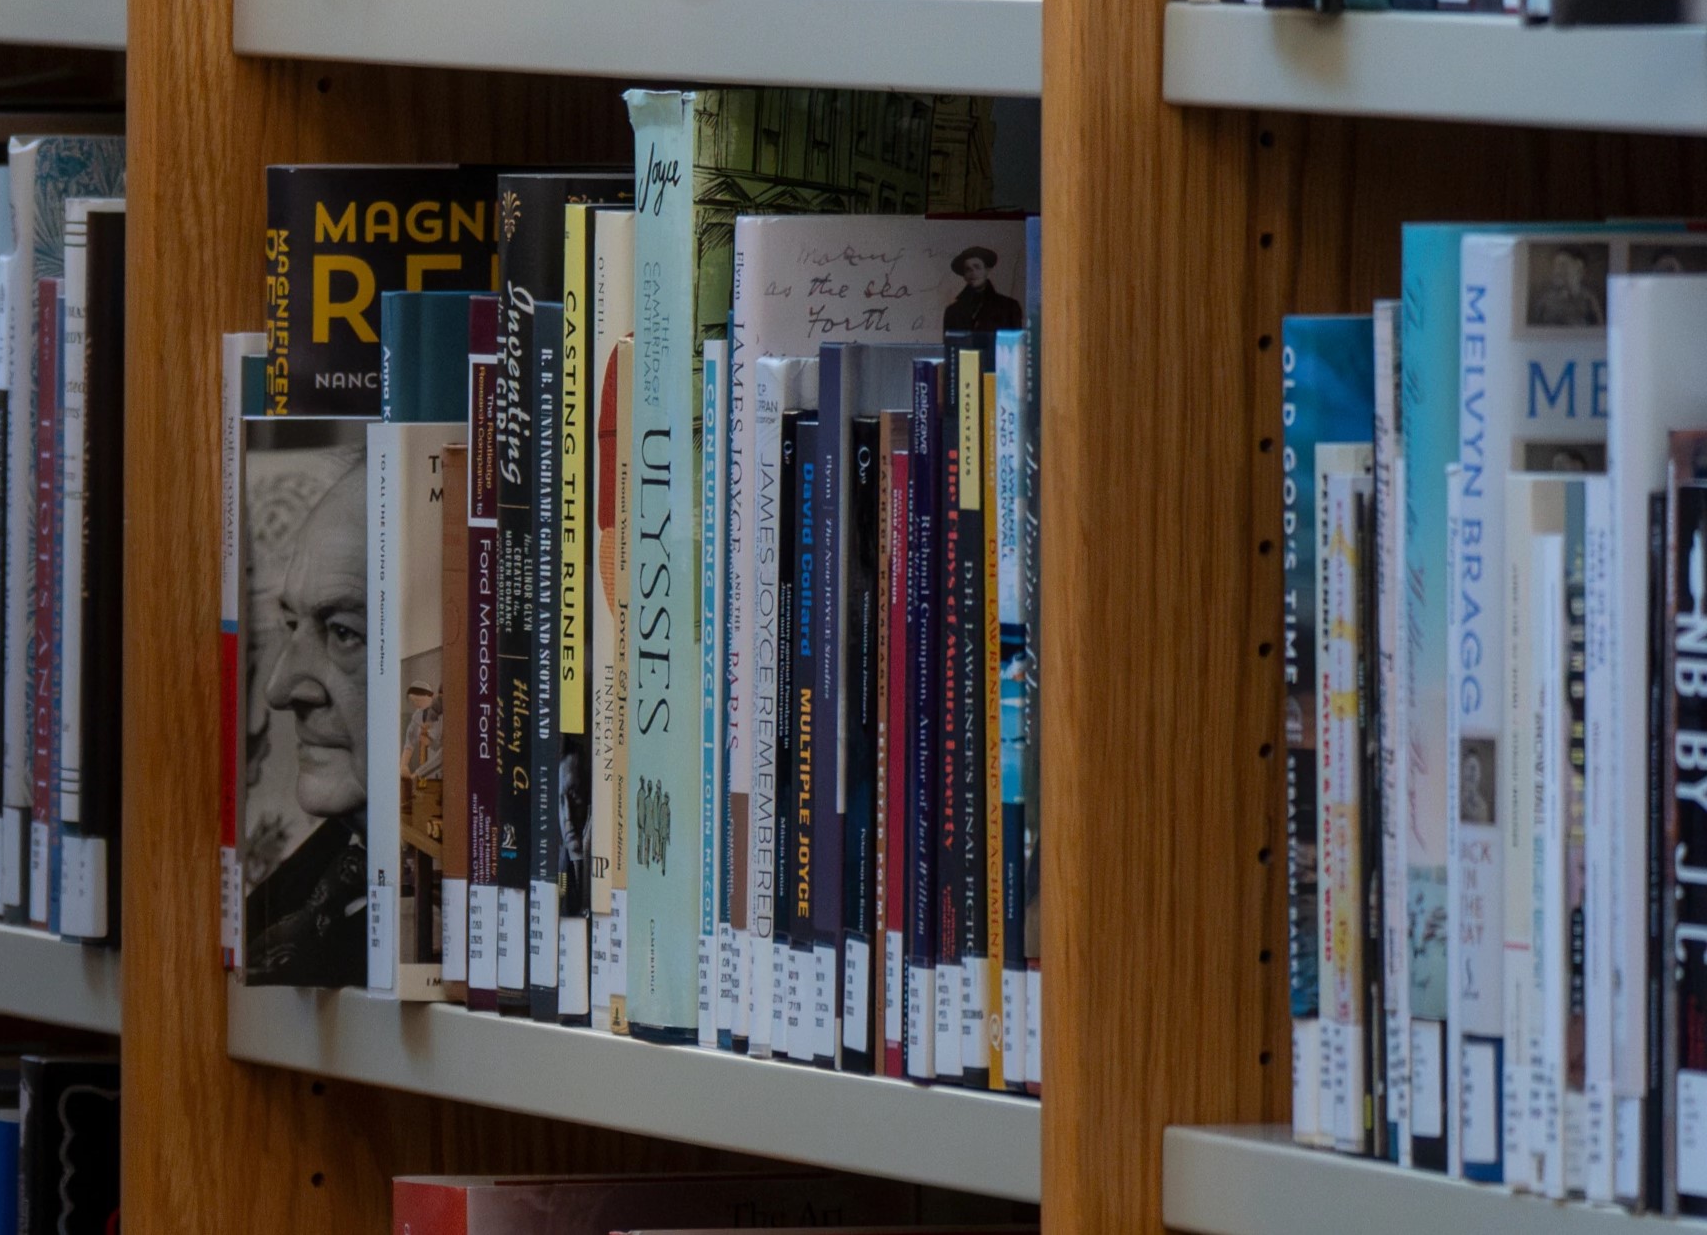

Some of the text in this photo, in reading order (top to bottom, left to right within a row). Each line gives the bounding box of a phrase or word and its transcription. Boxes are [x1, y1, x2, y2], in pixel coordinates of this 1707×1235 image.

[638, 141, 681, 217] Joyce
[500, 278, 535, 486] Inventing
[642, 261, 652, 409] CENTENARY
[651, 261, 662, 408] CAMBRIDGE
[661, 315, 670, 360] THE
[485, 393, 495, 490] The Routledge
[563, 289, 578, 683] CASTING THE RUNES
[917, 381, 930, 457] palgrave
[1000, 405, 1009, 563] AND CORNWALL
[1008, 411, 1017, 557] D.H. LAWRENCE
[380, 453, 388, 582] TO ALL THE LIVING
[537, 347, 554, 740] R. B. CUNNINGHAME GRAHAM AND SCOTLAND
[620, 461, 629, 572] Hiromi Yoshida
[705, 383, 716, 710] CONSUMING JOYCE
[800, 462, 816, 657] David Collard
[1282, 344, 1298, 686] OLD GOD'S TIME
[1460, 283, 1487, 717] MELVYN BRAGG
[477, 538, 492, 760] Ford Madox Ford
[636, 425, 674, 736] ULYSSES
[943, 448, 959, 852] The Plays of Maura Laverty
[1673, 614, 1706, 700] NB
[508, 678, 531, 796] Hilary A.
[595, 664, 615, 783] FINNEGANS WAKES
[756, 452, 777, 939] JAMES JOYCE REMEMBERED
[989, 538, 1001, 966] D.H. LAWRENCE AND ATTACHMENT
[1673, 729, 1705, 808] BY
[797, 687, 813, 919] MULTIPLE JOYCE
